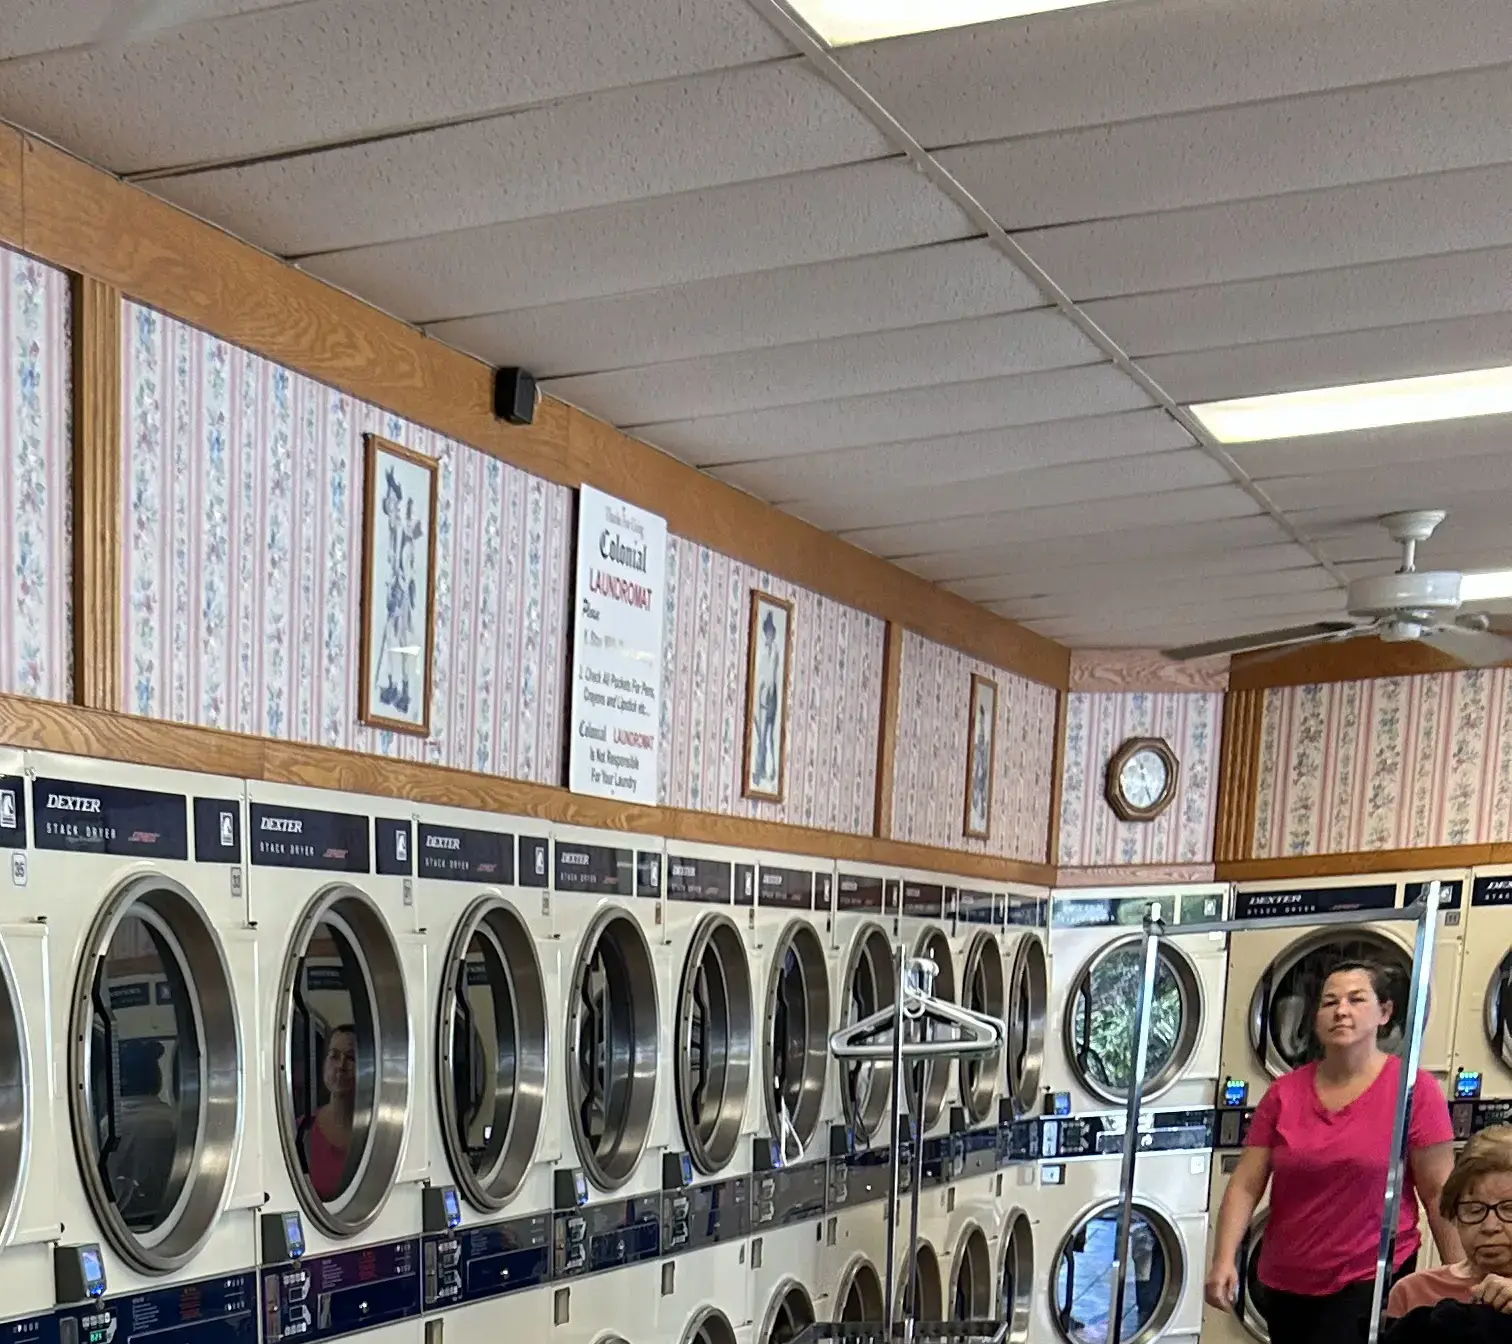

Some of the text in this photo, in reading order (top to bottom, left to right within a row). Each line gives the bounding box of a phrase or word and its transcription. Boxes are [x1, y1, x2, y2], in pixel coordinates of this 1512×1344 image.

[599, 528, 647, 573] Colonial
[589, 566, 652, 611] LAUNDROMAT
[46, 794, 102, 813] DEXTER
[46, 822, 79, 837] STACK
[260, 817, 303, 833] DEXTER
[424, 834, 461, 850] DEXTER
[1249, 894, 1302, 905] DEXTER
